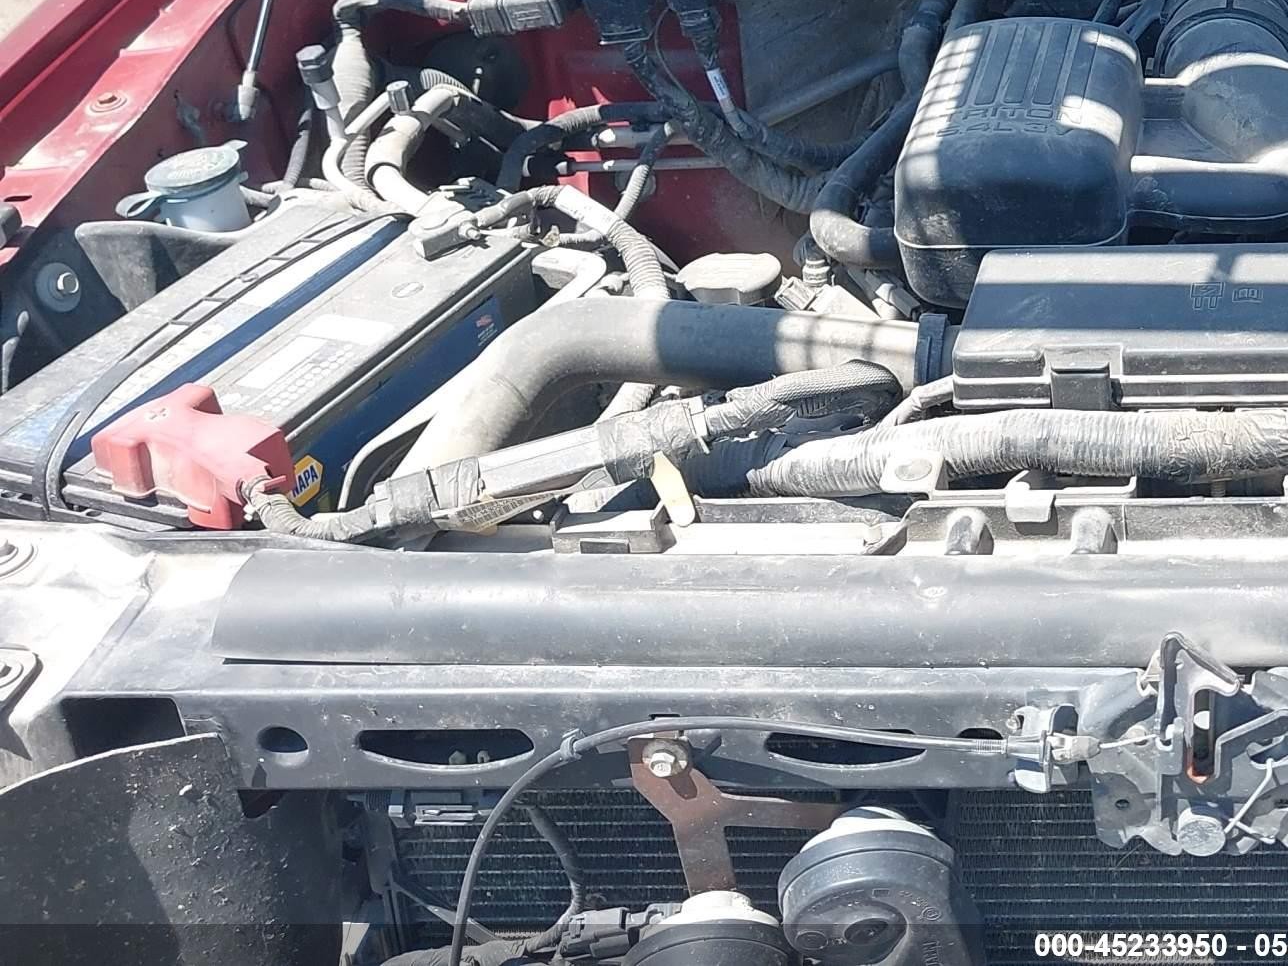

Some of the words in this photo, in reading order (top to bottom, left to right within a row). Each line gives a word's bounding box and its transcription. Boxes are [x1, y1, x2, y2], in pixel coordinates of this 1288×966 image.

[939, 106, 1082, 124] TRITON
[936, 121, 1013, 137] 5.4L
[291, 465, 319, 498] NAPA
